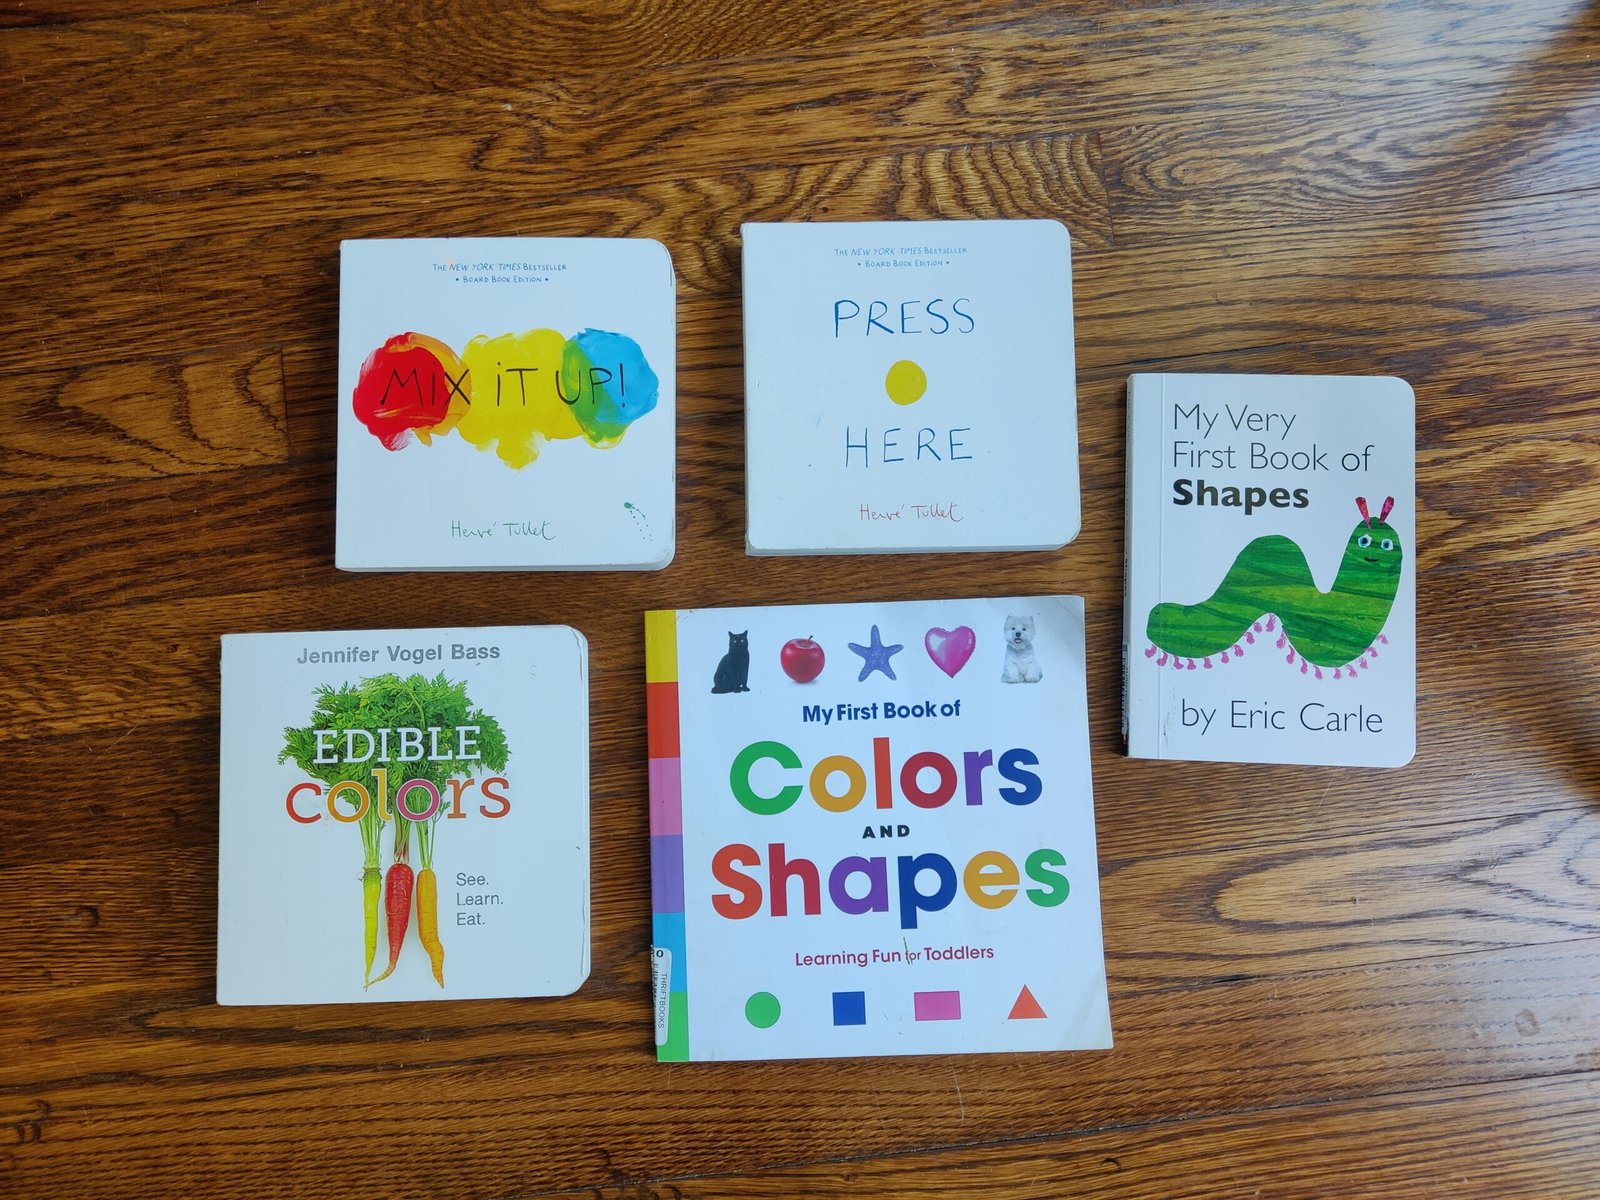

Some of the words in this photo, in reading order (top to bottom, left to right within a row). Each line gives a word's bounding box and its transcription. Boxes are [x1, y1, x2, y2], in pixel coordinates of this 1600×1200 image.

[834, 248, 848, 256] THE
[850, 247, 870, 256] NEW
[873, 247, 896, 256] YORK
[899, 246, 922, 255] TIMES
[924, 246, 967, 255] BESTSELLER
[864, 260, 891, 268] BOARD
[893, 259, 912, 267] BOOK
[432, 263, 446, 272] THE
[449, 263, 469, 272] NEW
[472, 263, 494, 272] YORK
[498, 263, 520, 272] TIMES
[522, 263, 567, 272] BESTSELLER
[463, 275, 489, 283] BOARD
[491, 275, 511, 283] BOOK
[834, 297, 975, 338] PRESS
[555, 362, 626, 407] UP!
[1173, 403, 1219, 438] My
[1225, 403, 1297, 439] Very
[845, 425, 973, 468] HERE
[1173, 441, 1236, 469] First
[1250, 442, 1329, 471] Book
[1341, 445, 1375, 472] of
[1172, 478, 1310, 516] Shapes
[911, 502, 964, 522] Tullet
[502, 520, 556, 540] Tullet
[296, 646, 380, 664] Jennifer
[386, 644, 443, 664] Vogel
[450, 642, 501, 660] Bass
[802, 704, 834, 726] My
[836, 702, 879, 721] First
[884, 701, 938, 719] Book
[939, 699, 961, 717] of
[1181, 698, 1216, 735] by
[1231, 699, 1286, 730] Eric
[1300, 702, 1383, 732] Carle
[313, 725, 481, 764] EDIBLE
[729, 737, 1043, 816] Colors
[285, 768, 512, 824] colors
[862, 824, 911, 839] AND
[456, 872, 490, 887] See.
[711, 843, 1071, 930] Shapes
[456, 893, 504, 906] Learn.
[456, 912, 486, 926] Eat.
[795, 951, 868, 968] Learning
[872, 949, 901, 963] Fun
[904, 949, 921, 962] for
[923, 945, 994, 961] Toddlers
[657, 973, 668, 1029] THRIFTBOOKS
